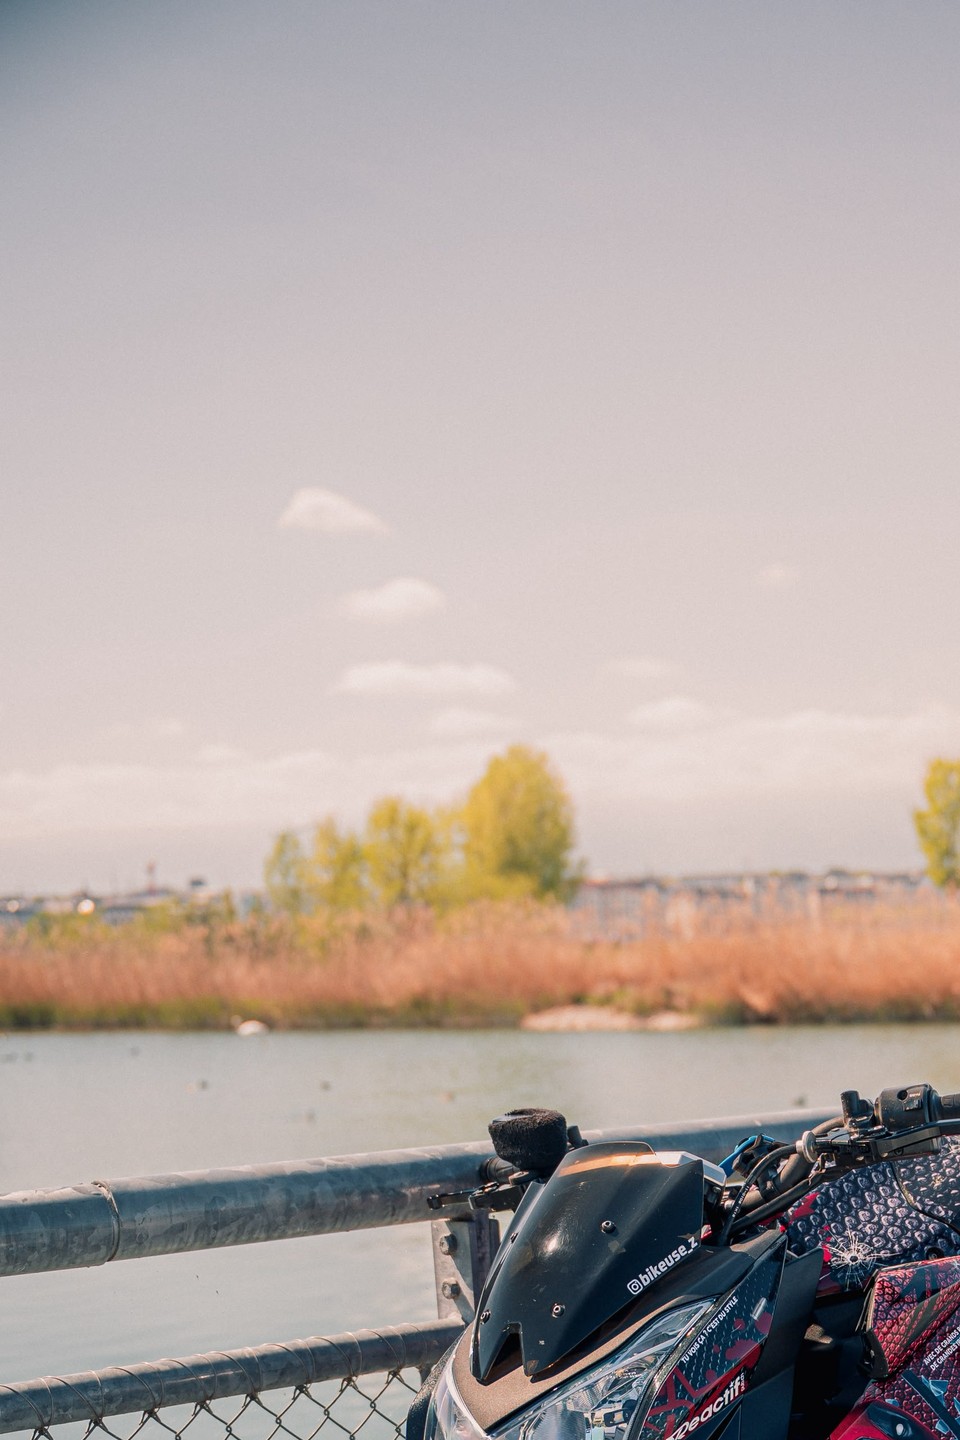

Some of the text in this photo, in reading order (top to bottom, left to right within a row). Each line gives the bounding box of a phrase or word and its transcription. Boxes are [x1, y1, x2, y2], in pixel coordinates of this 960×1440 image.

[681, 1353, 690, 1364] TU
[688, 1343, 700, 1357] VOIS
[697, 1334, 706, 1345] ÇA
[706, 1317, 720, 1333] C'EST
[717, 1312, 727, 1321] DU
[723, 1295, 739, 1314] STYLE
[923, 1351, 938, 1366] AVEC
[934, 1345, 944, 1354] DE
[940, 1329, 959, 1348] GRANDS
[930, 1361, 940, 1371] DE
[937, 1343, 958, 1364] GRANDES
